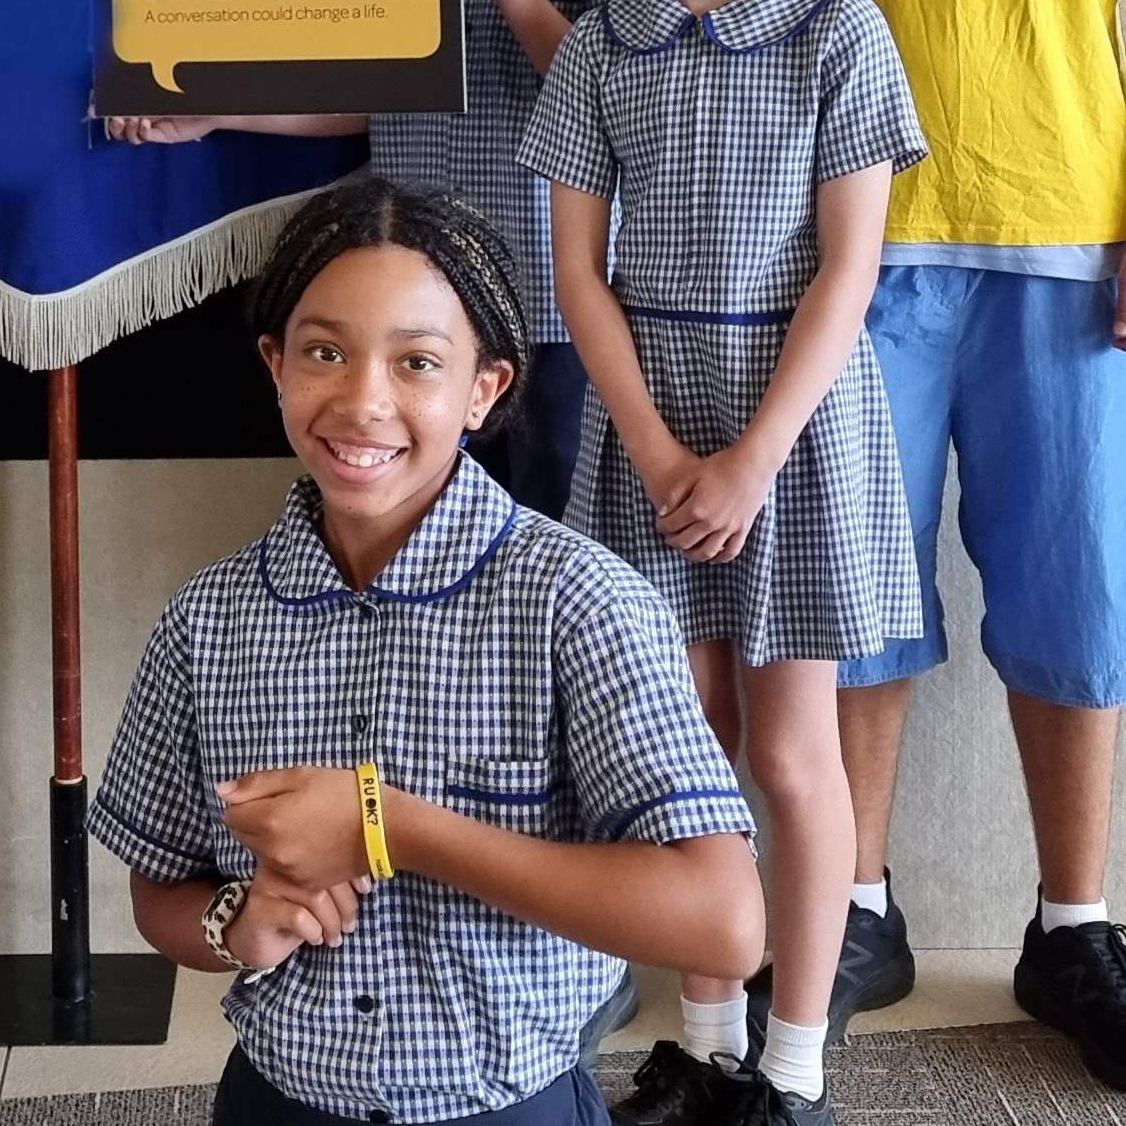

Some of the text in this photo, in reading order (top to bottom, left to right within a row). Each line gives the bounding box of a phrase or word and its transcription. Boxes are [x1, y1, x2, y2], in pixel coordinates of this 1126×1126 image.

[144, 4, 389, 24] A conversation could change a life.
